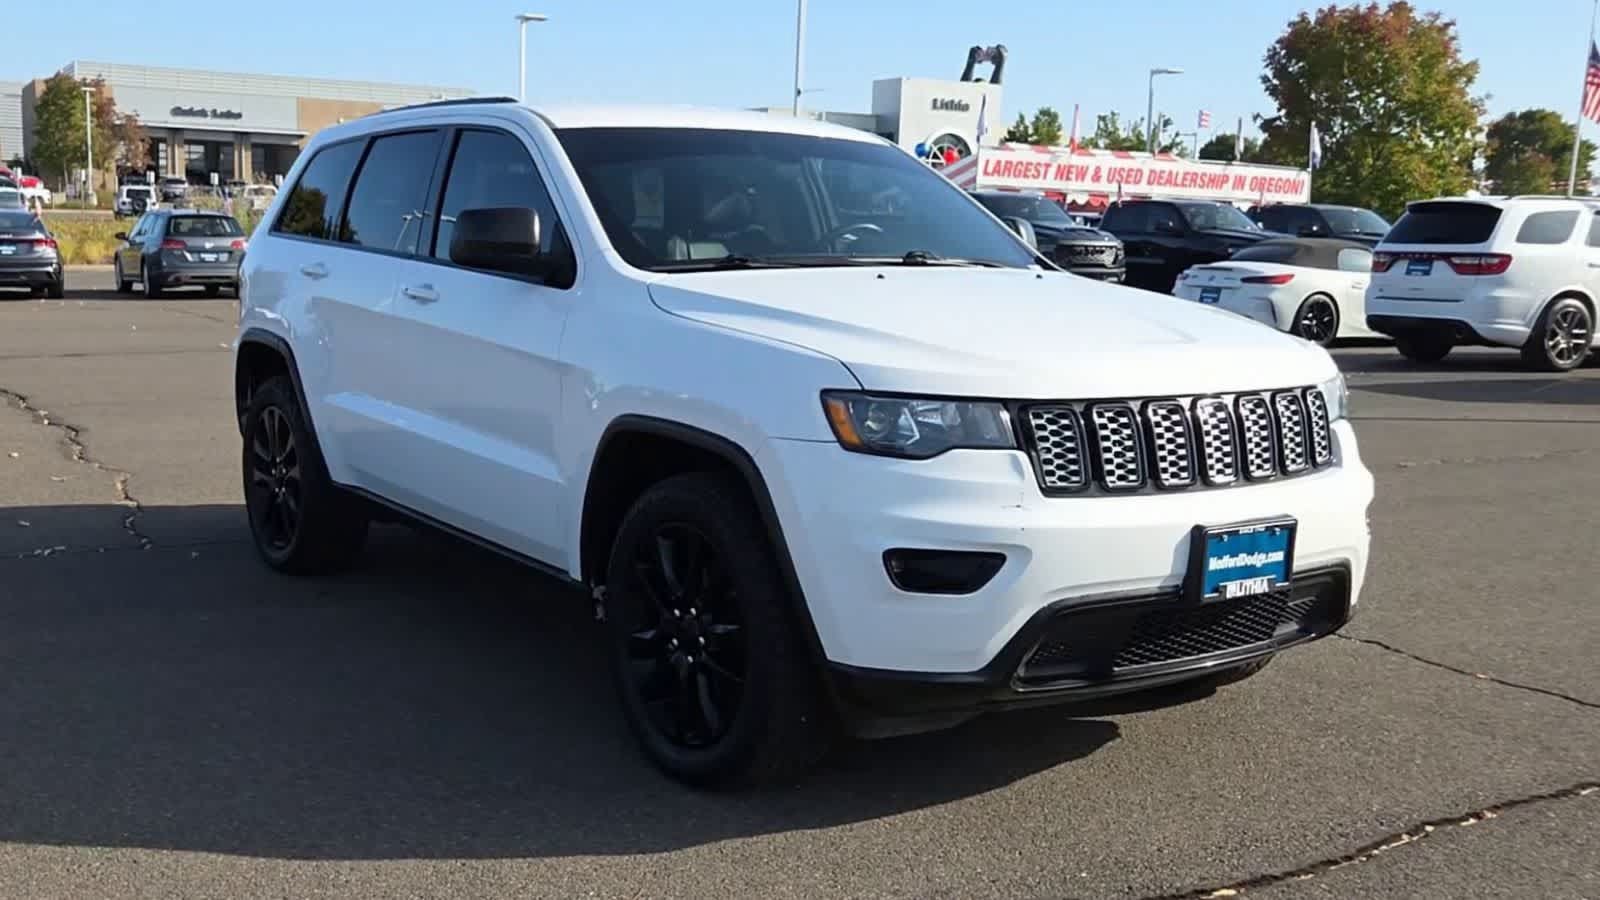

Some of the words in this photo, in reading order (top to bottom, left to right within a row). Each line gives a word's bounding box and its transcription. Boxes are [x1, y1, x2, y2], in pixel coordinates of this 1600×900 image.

[982, 159, 1051, 180] LARGEST
[1054, 163, 1088, 182] NEW
[1091, 166, 1103, 184] &
[1106, 167, 1143, 184] USED
[1147, 169, 1229, 190] DEALERSHIP
[1232, 174, 1246, 190] IN
[1249, 175, 1305, 196] OREGON!
